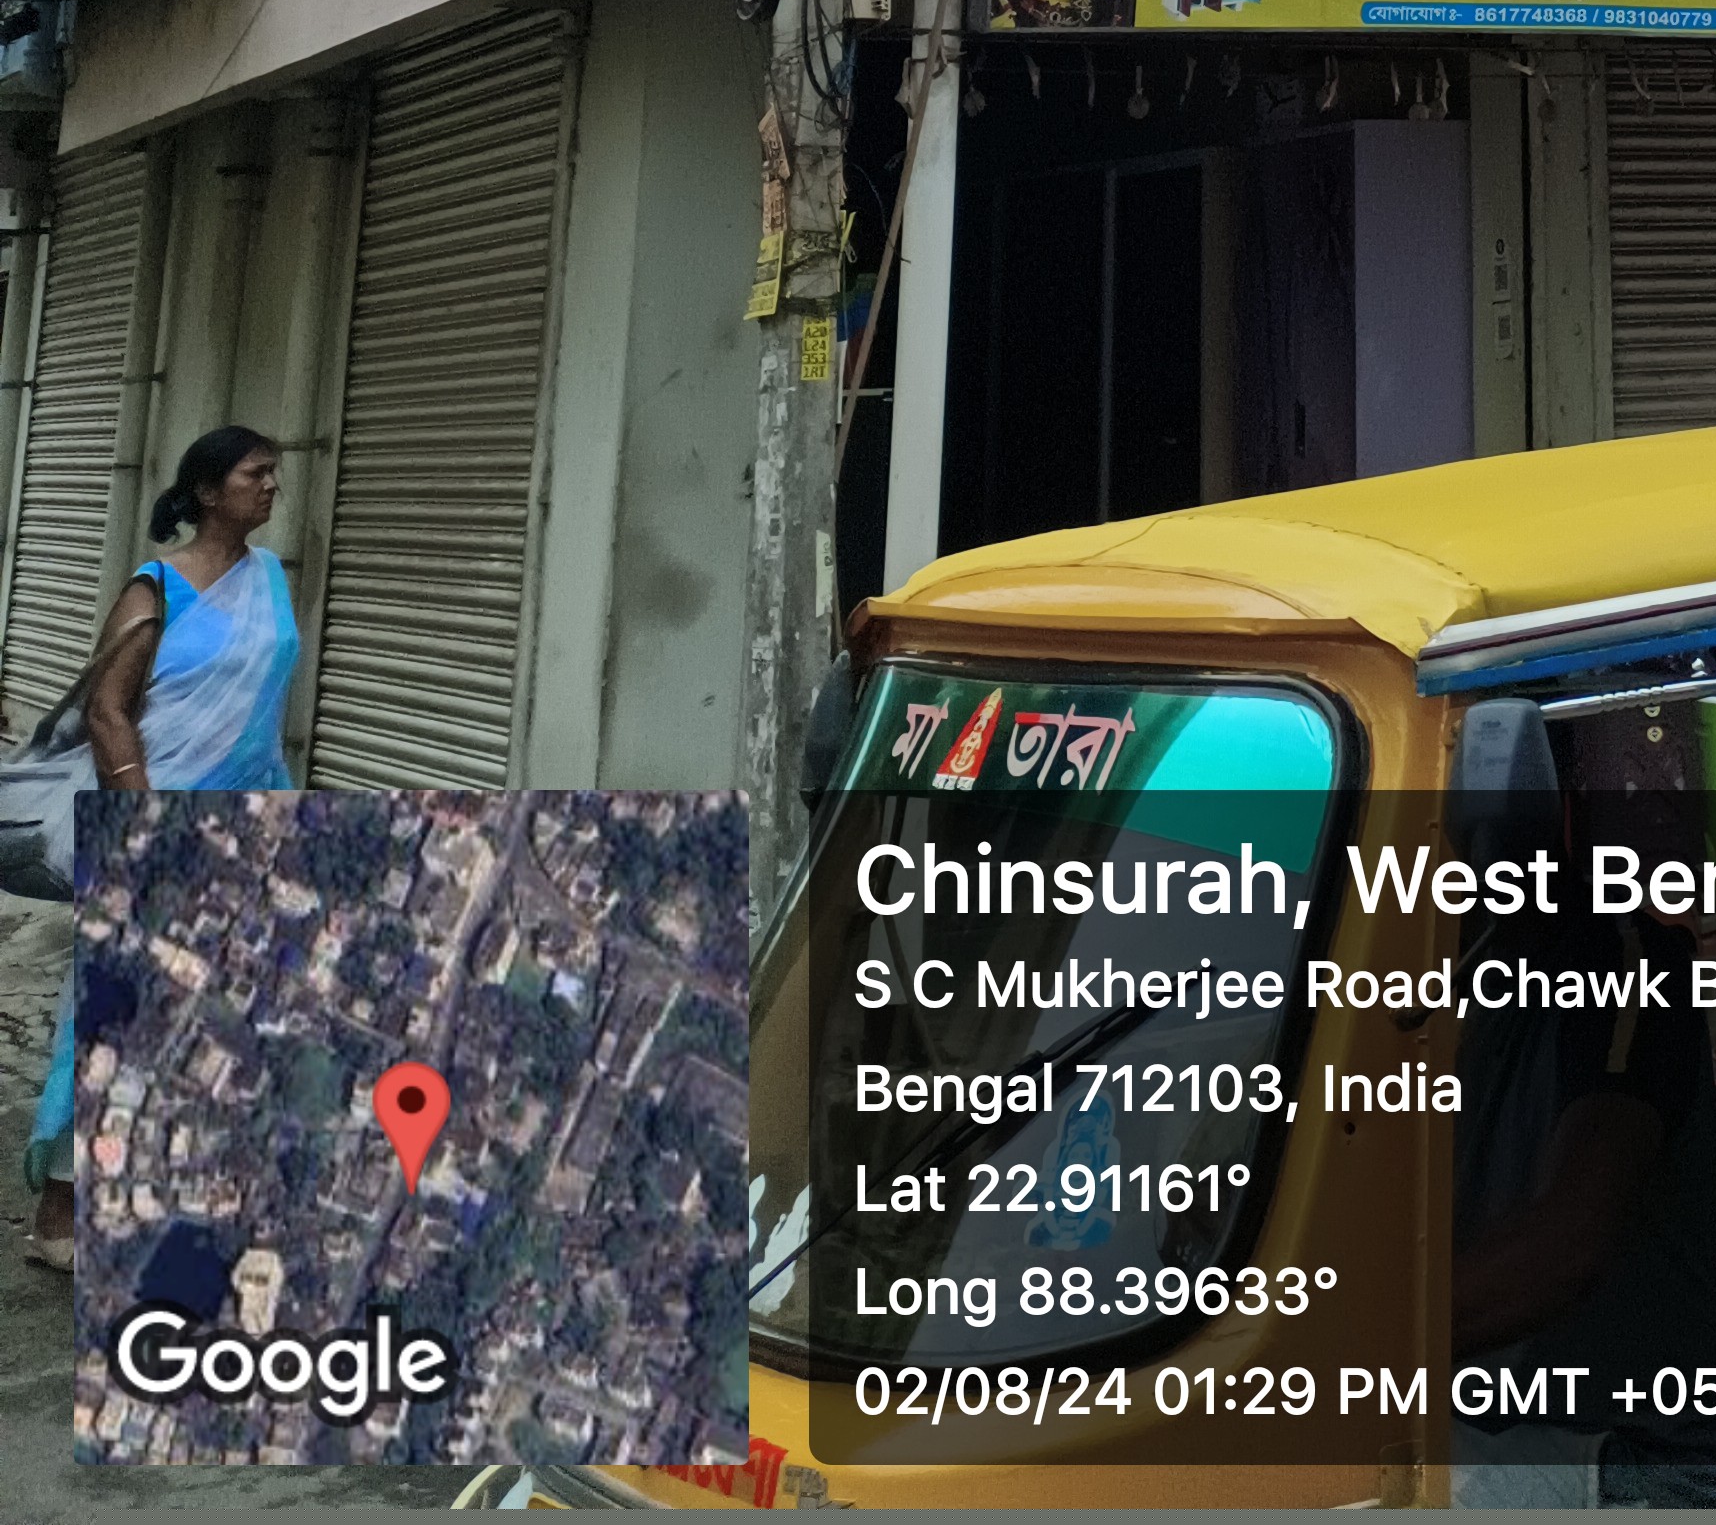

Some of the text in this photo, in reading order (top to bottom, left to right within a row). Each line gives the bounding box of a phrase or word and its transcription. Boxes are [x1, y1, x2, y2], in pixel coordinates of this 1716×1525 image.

[1604, 9, 1712, 27] 9831040779
[892, 697, 1136, 794] মা তারা
